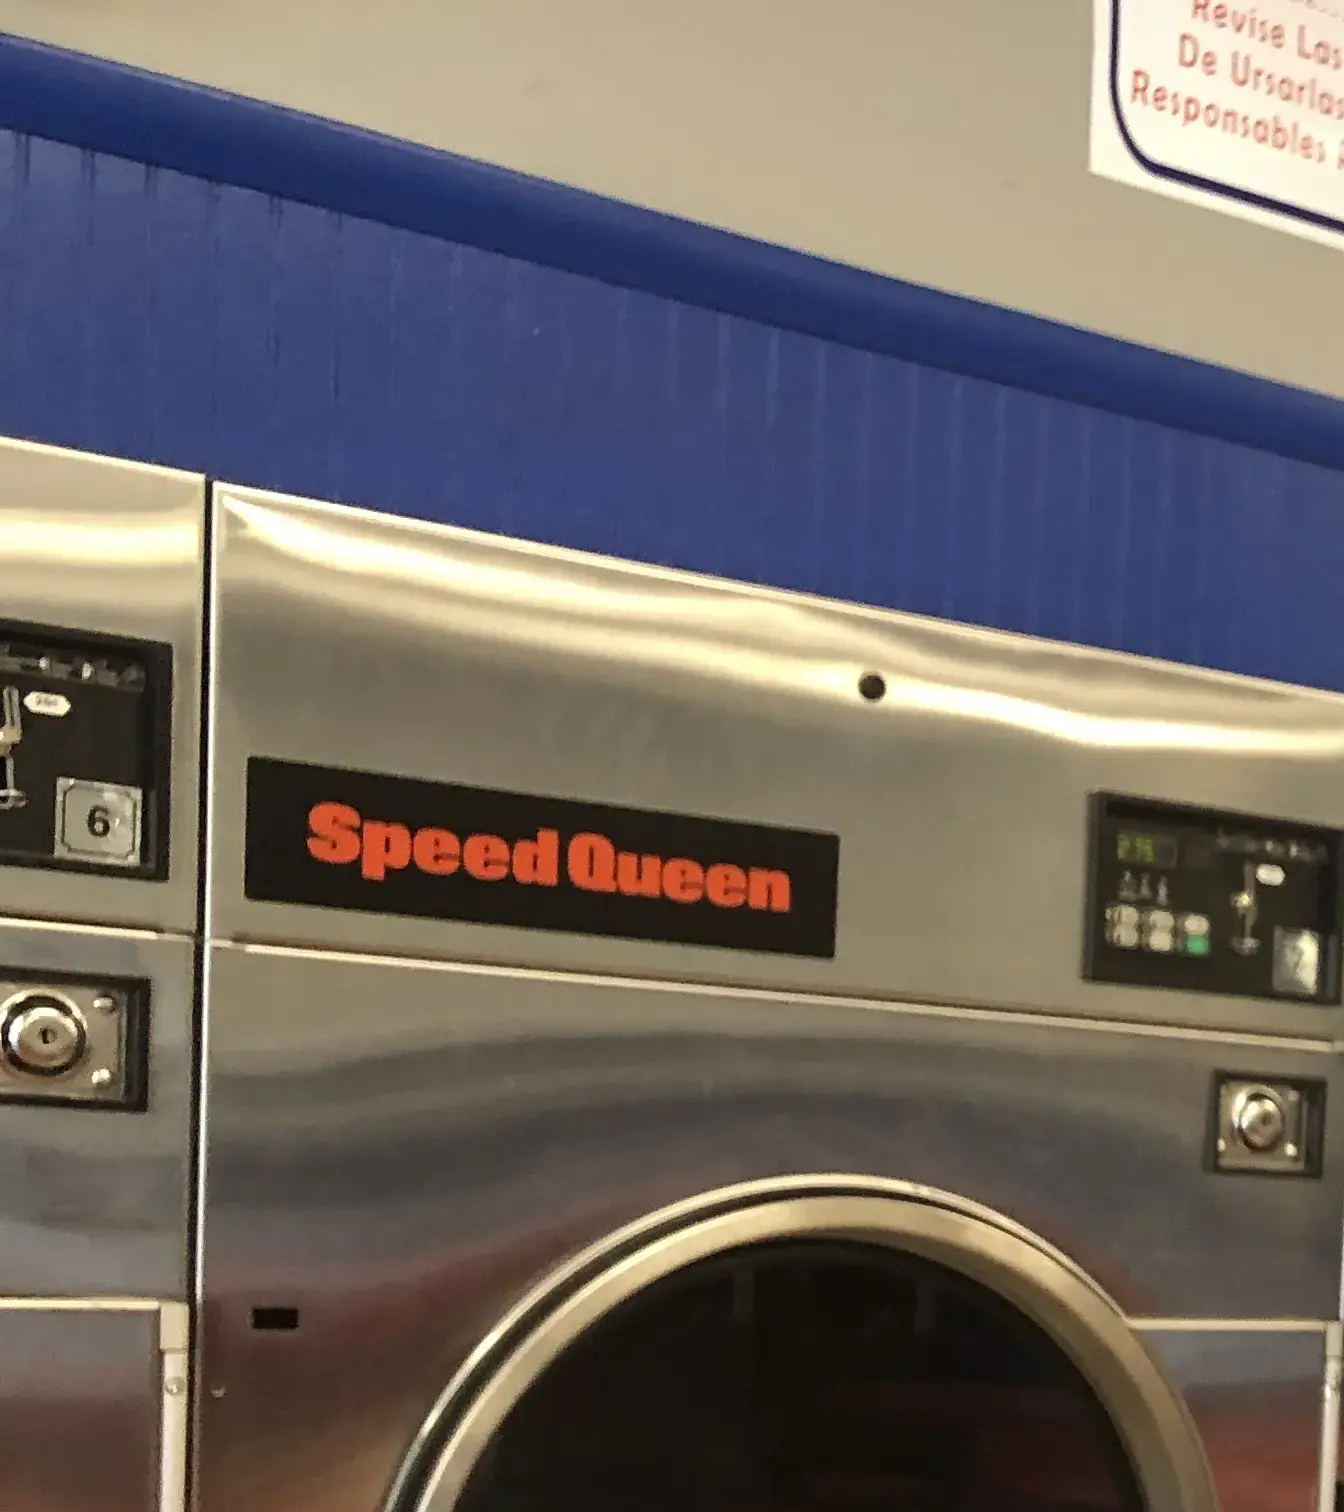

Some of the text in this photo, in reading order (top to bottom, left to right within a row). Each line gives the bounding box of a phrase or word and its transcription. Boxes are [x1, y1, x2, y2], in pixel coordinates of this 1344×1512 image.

[1177, 32, 1217, 76] De
[1192, 0, 1285, 49] Revise
[1297, 24, 1343, 71] Las
[1131, 69, 1327, 164] Responsables
[87, 804, 111, 838] 6
[306, 801, 791, 914] Speed Queen
